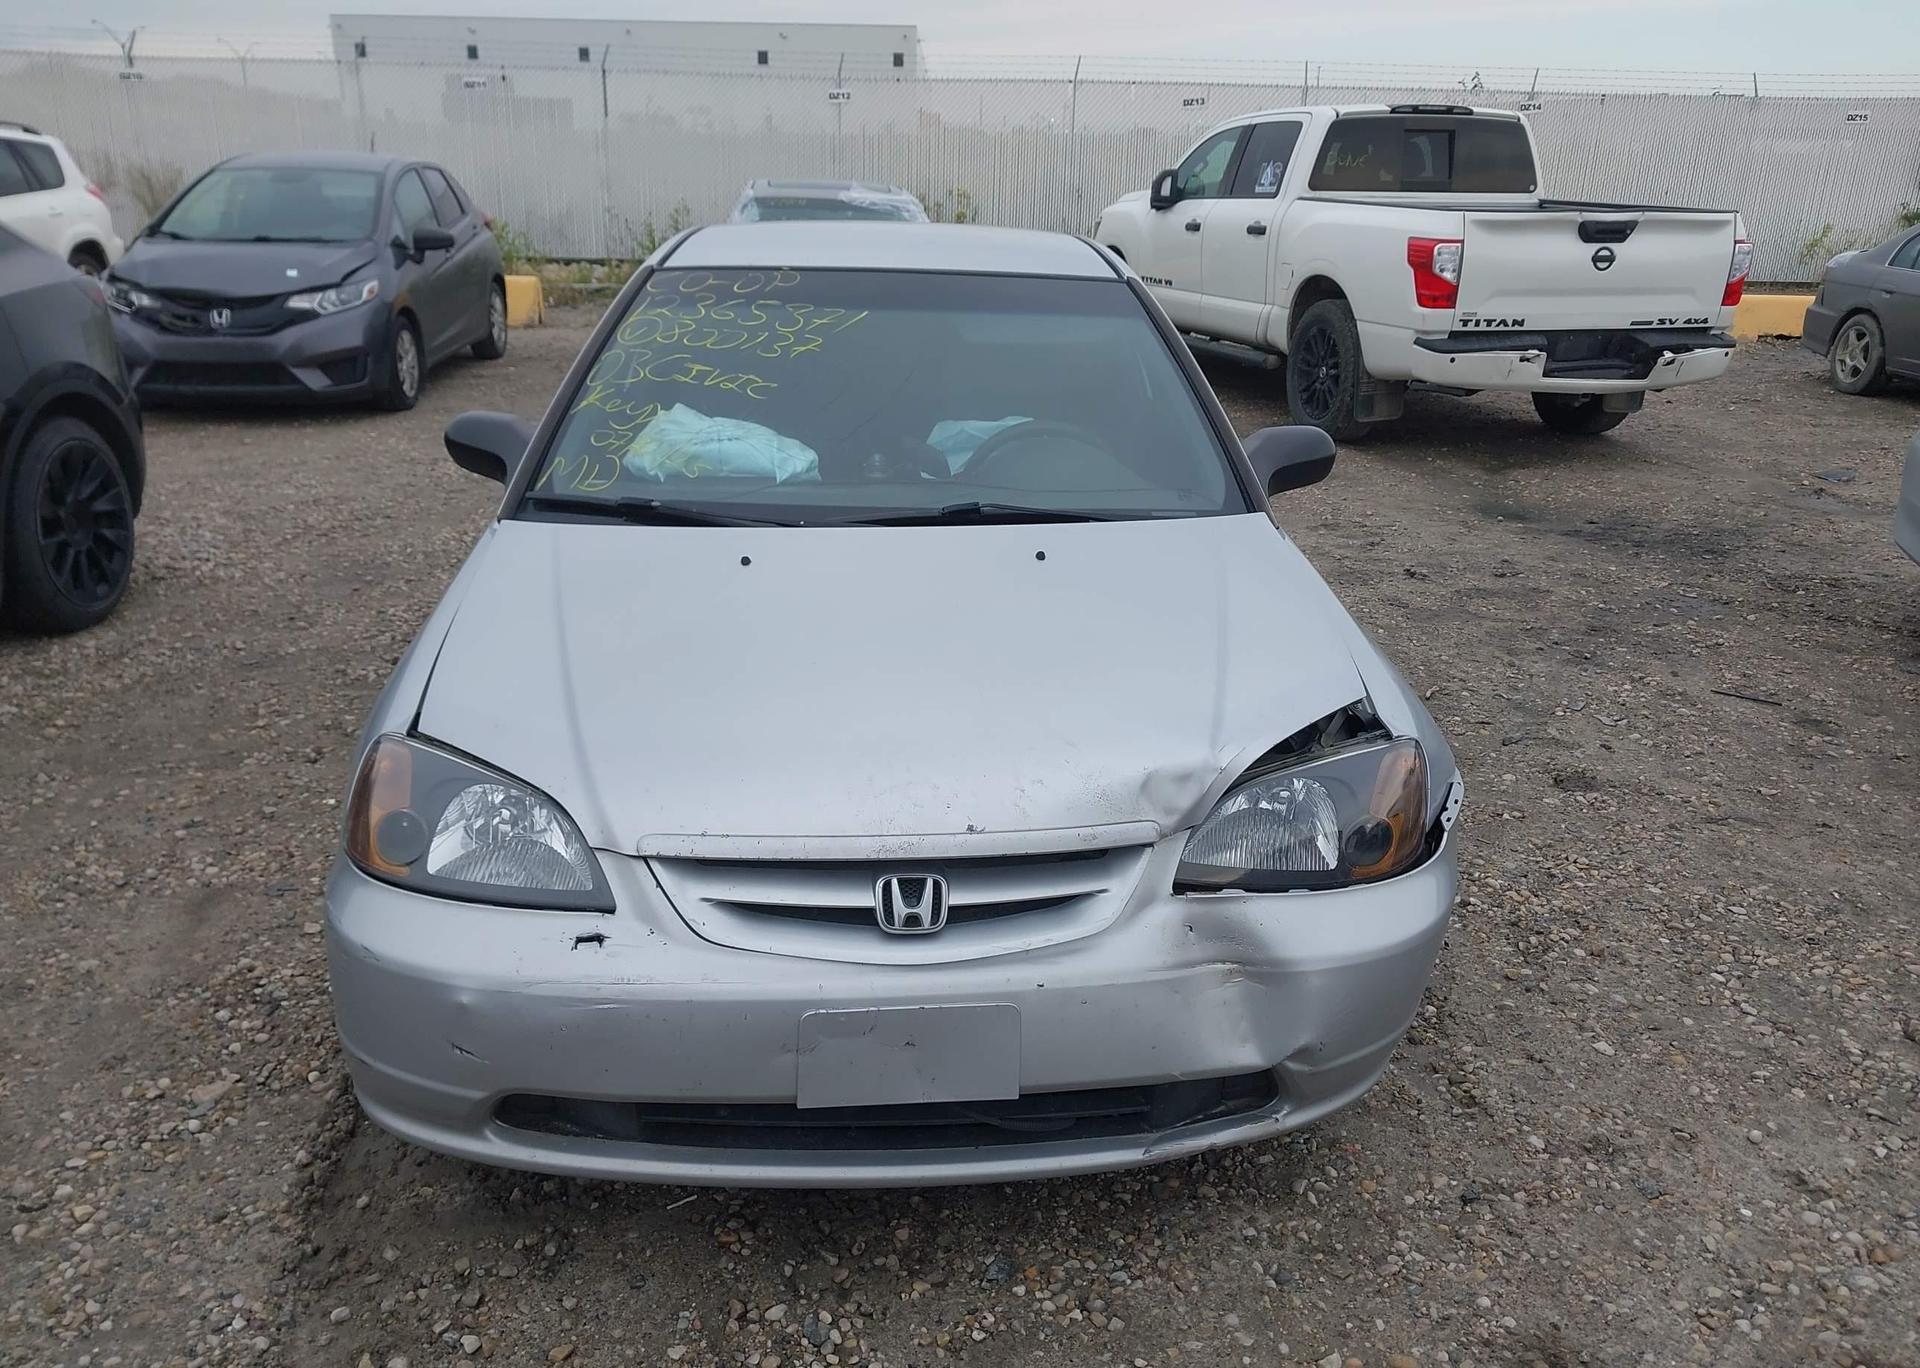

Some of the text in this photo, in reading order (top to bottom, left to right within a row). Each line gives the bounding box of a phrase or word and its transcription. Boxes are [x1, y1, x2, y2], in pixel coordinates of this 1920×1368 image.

[828, 92, 851, 100] DZ12
[1183, 97, 1205, 106] DZ13
[1520, 102, 1542, 111] DZ14
[1846, 113, 1869, 122] DZ15
[1141, 276, 1163, 285] TITAN
[1459, 318, 1526, 328] TITAN
[1656, 318, 1679, 326] SV
